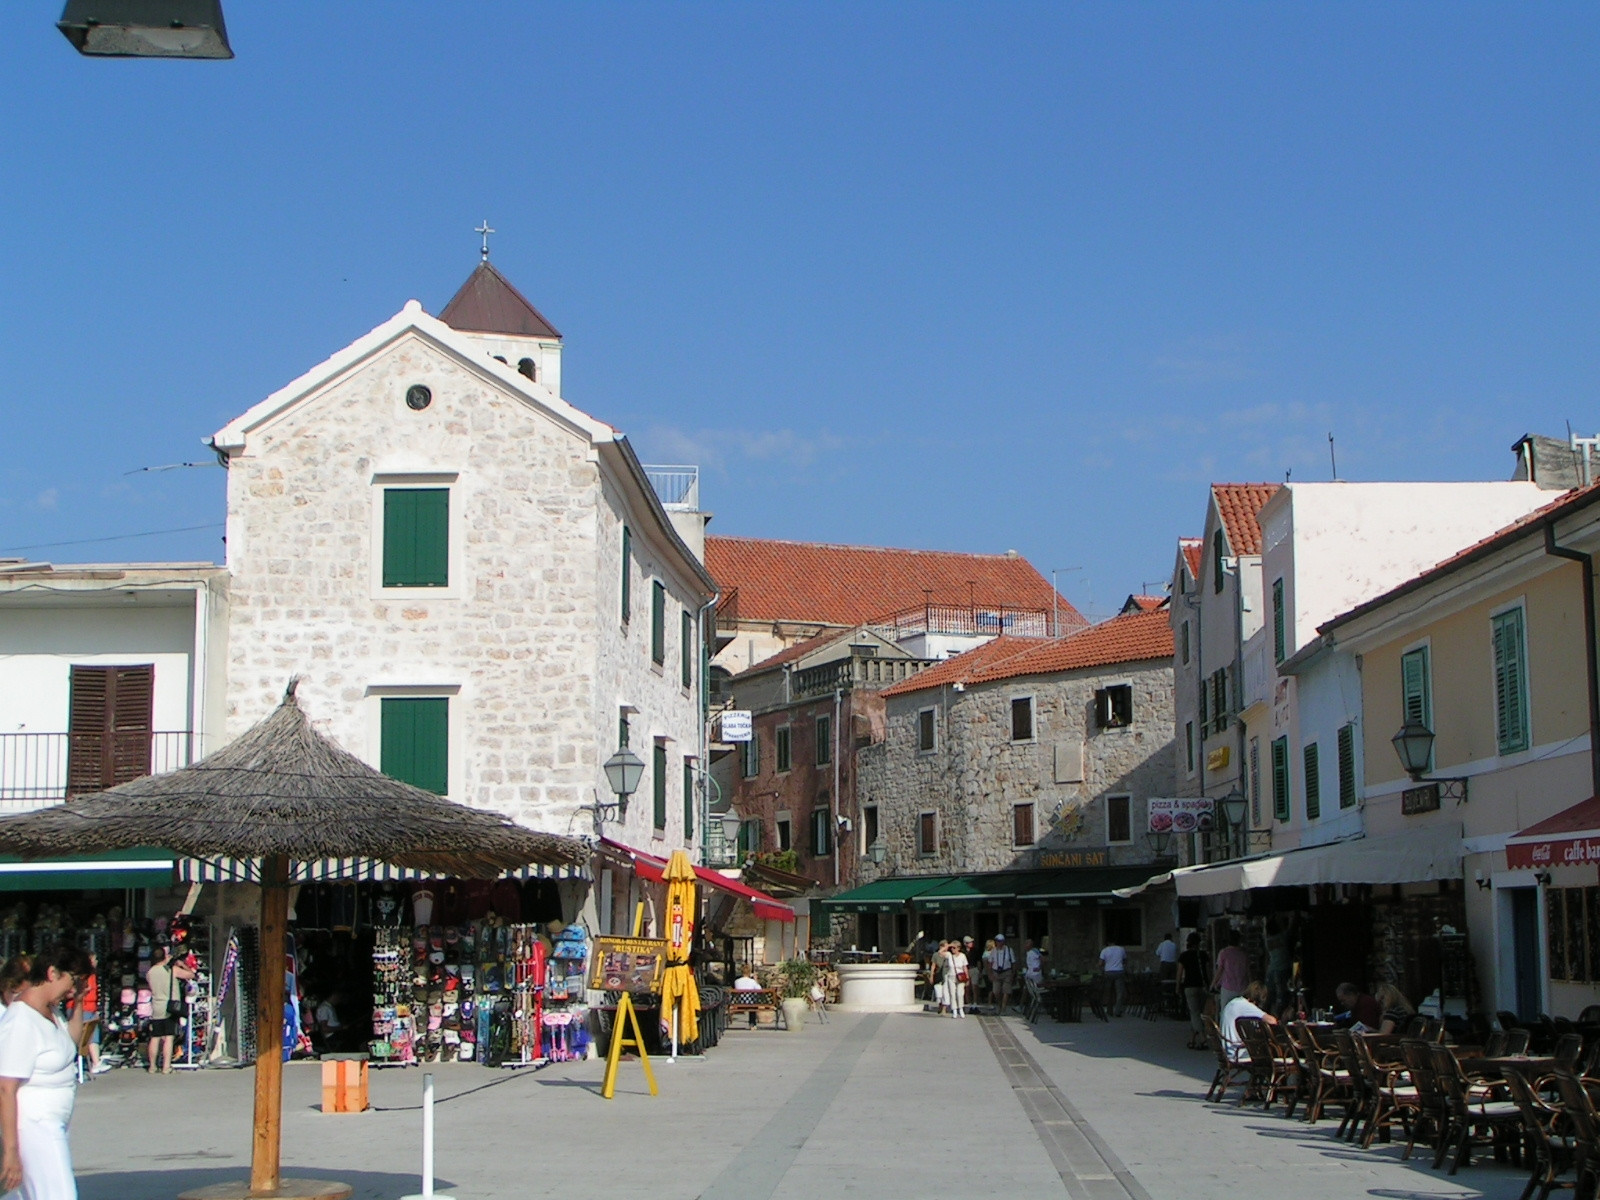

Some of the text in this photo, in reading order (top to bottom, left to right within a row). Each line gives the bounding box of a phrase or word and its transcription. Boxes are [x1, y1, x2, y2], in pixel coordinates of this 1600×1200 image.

[724, 712, 750, 720] PIZZERIA
[1151, 800, 1171, 810] pizza
[1174, 800, 1179, 809] &
[1564, 839, 1585, 860] caffe
[1586, 839, 1600, 859] bar
[1040, 851, 1105, 867] SUNČANI SAT
[613, 945, 654, 954] "RUSTIKA"
